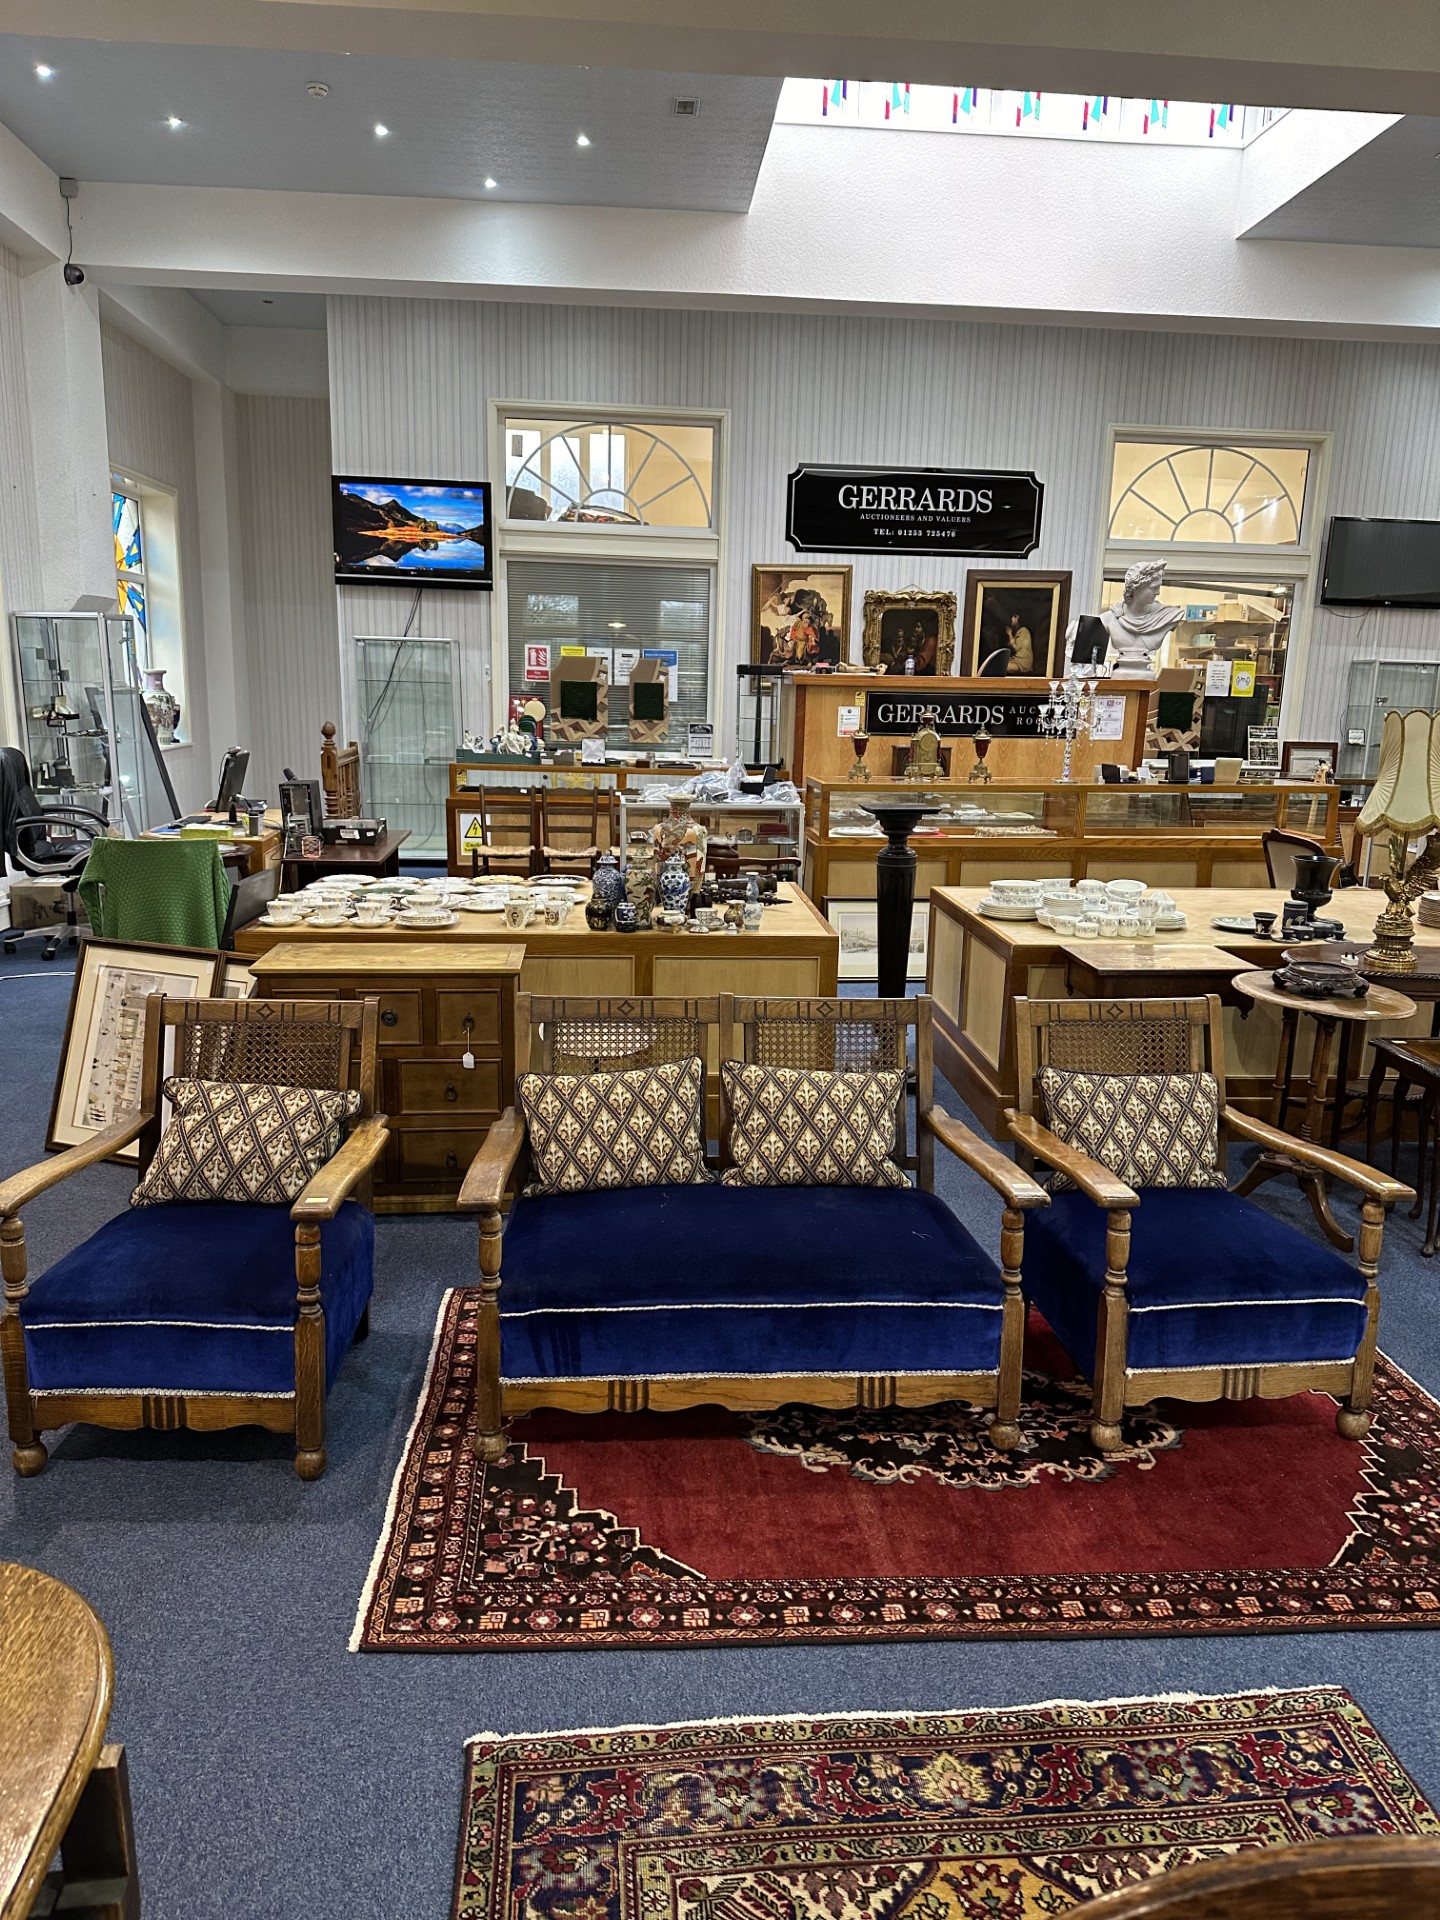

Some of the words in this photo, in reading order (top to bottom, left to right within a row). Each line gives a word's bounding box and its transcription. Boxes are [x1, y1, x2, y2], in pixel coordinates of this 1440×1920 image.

[838, 484, 993, 513] GERRARDS
[860, 513, 915, 521] AUCTIONEERS
[873, 528, 895, 536] TEL:
[926, 530, 956, 538] 725476
[877, 703, 1005, 725] GERRARDS
